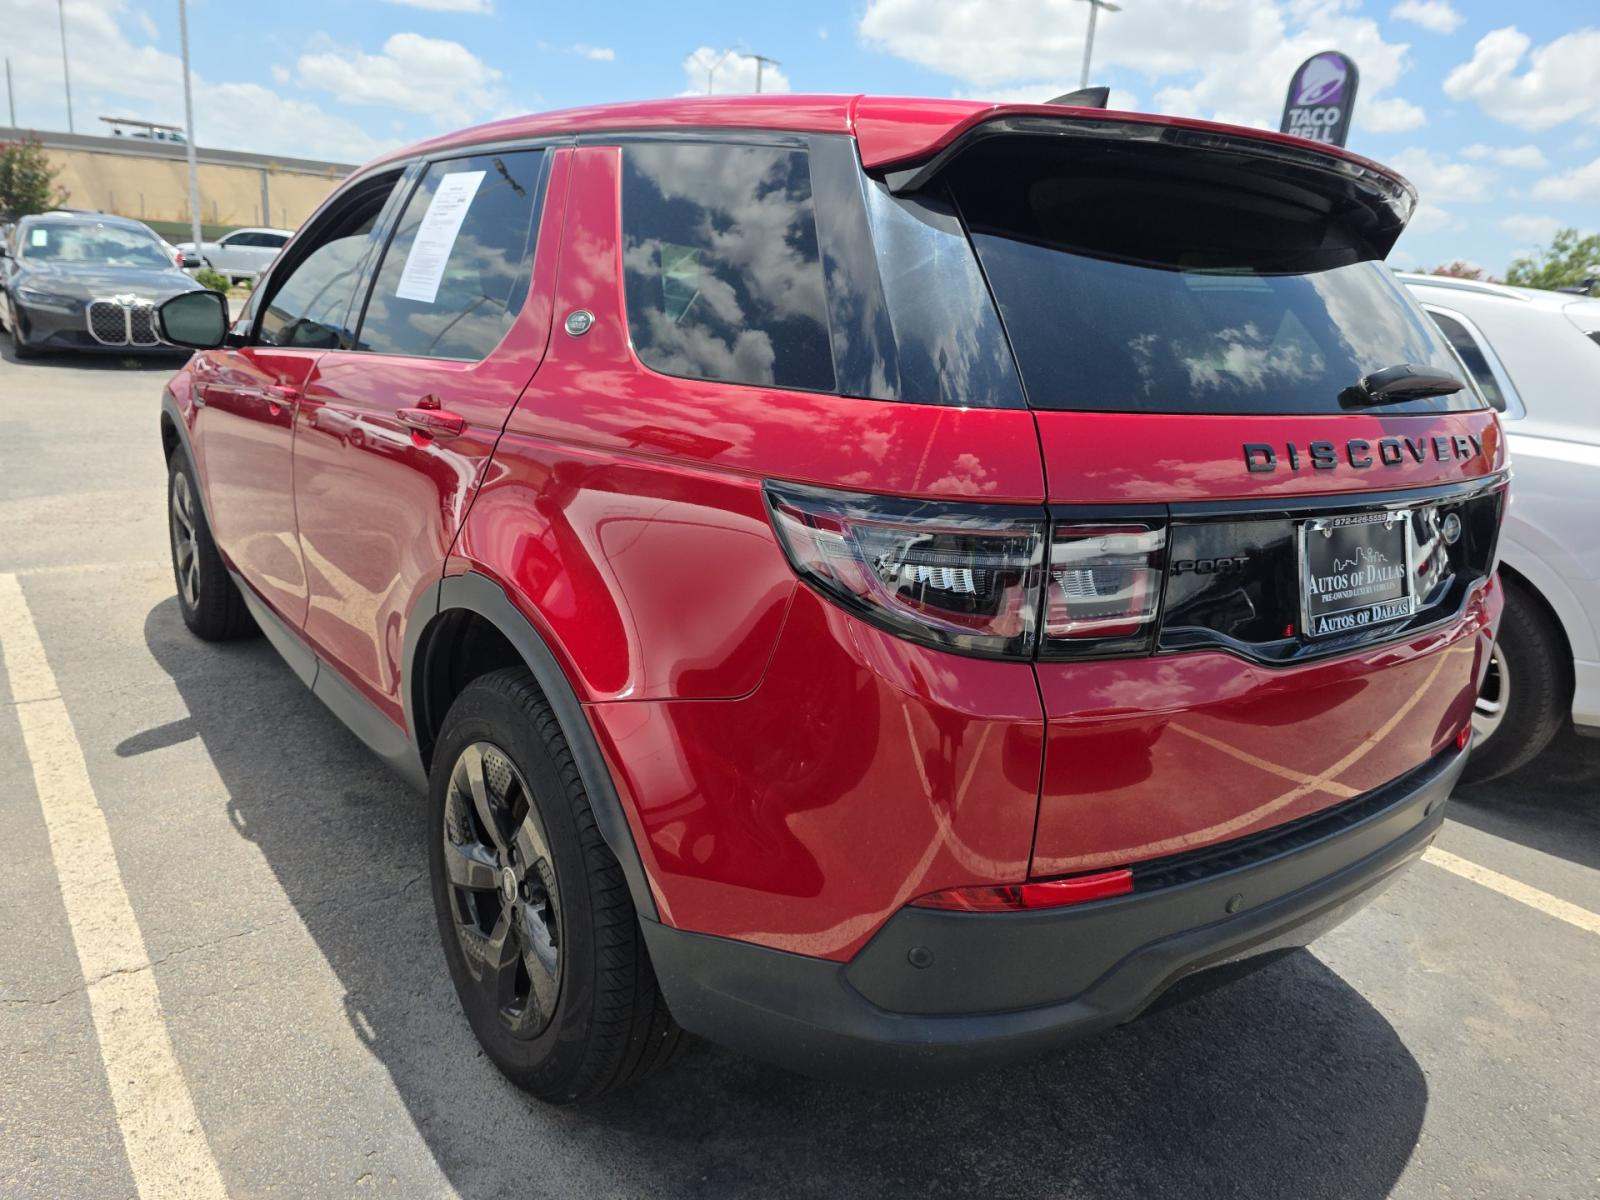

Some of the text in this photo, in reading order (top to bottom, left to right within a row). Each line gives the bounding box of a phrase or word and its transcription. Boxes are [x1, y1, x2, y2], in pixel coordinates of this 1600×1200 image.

[1288, 106, 1340, 127] TACO
[1242, 433, 1483, 473] DISCOVERY
[1310, 563, 1405, 595] AUTOS OF DALLAS
[1319, 603, 1408, 633] AUTOS OF DALLAS
